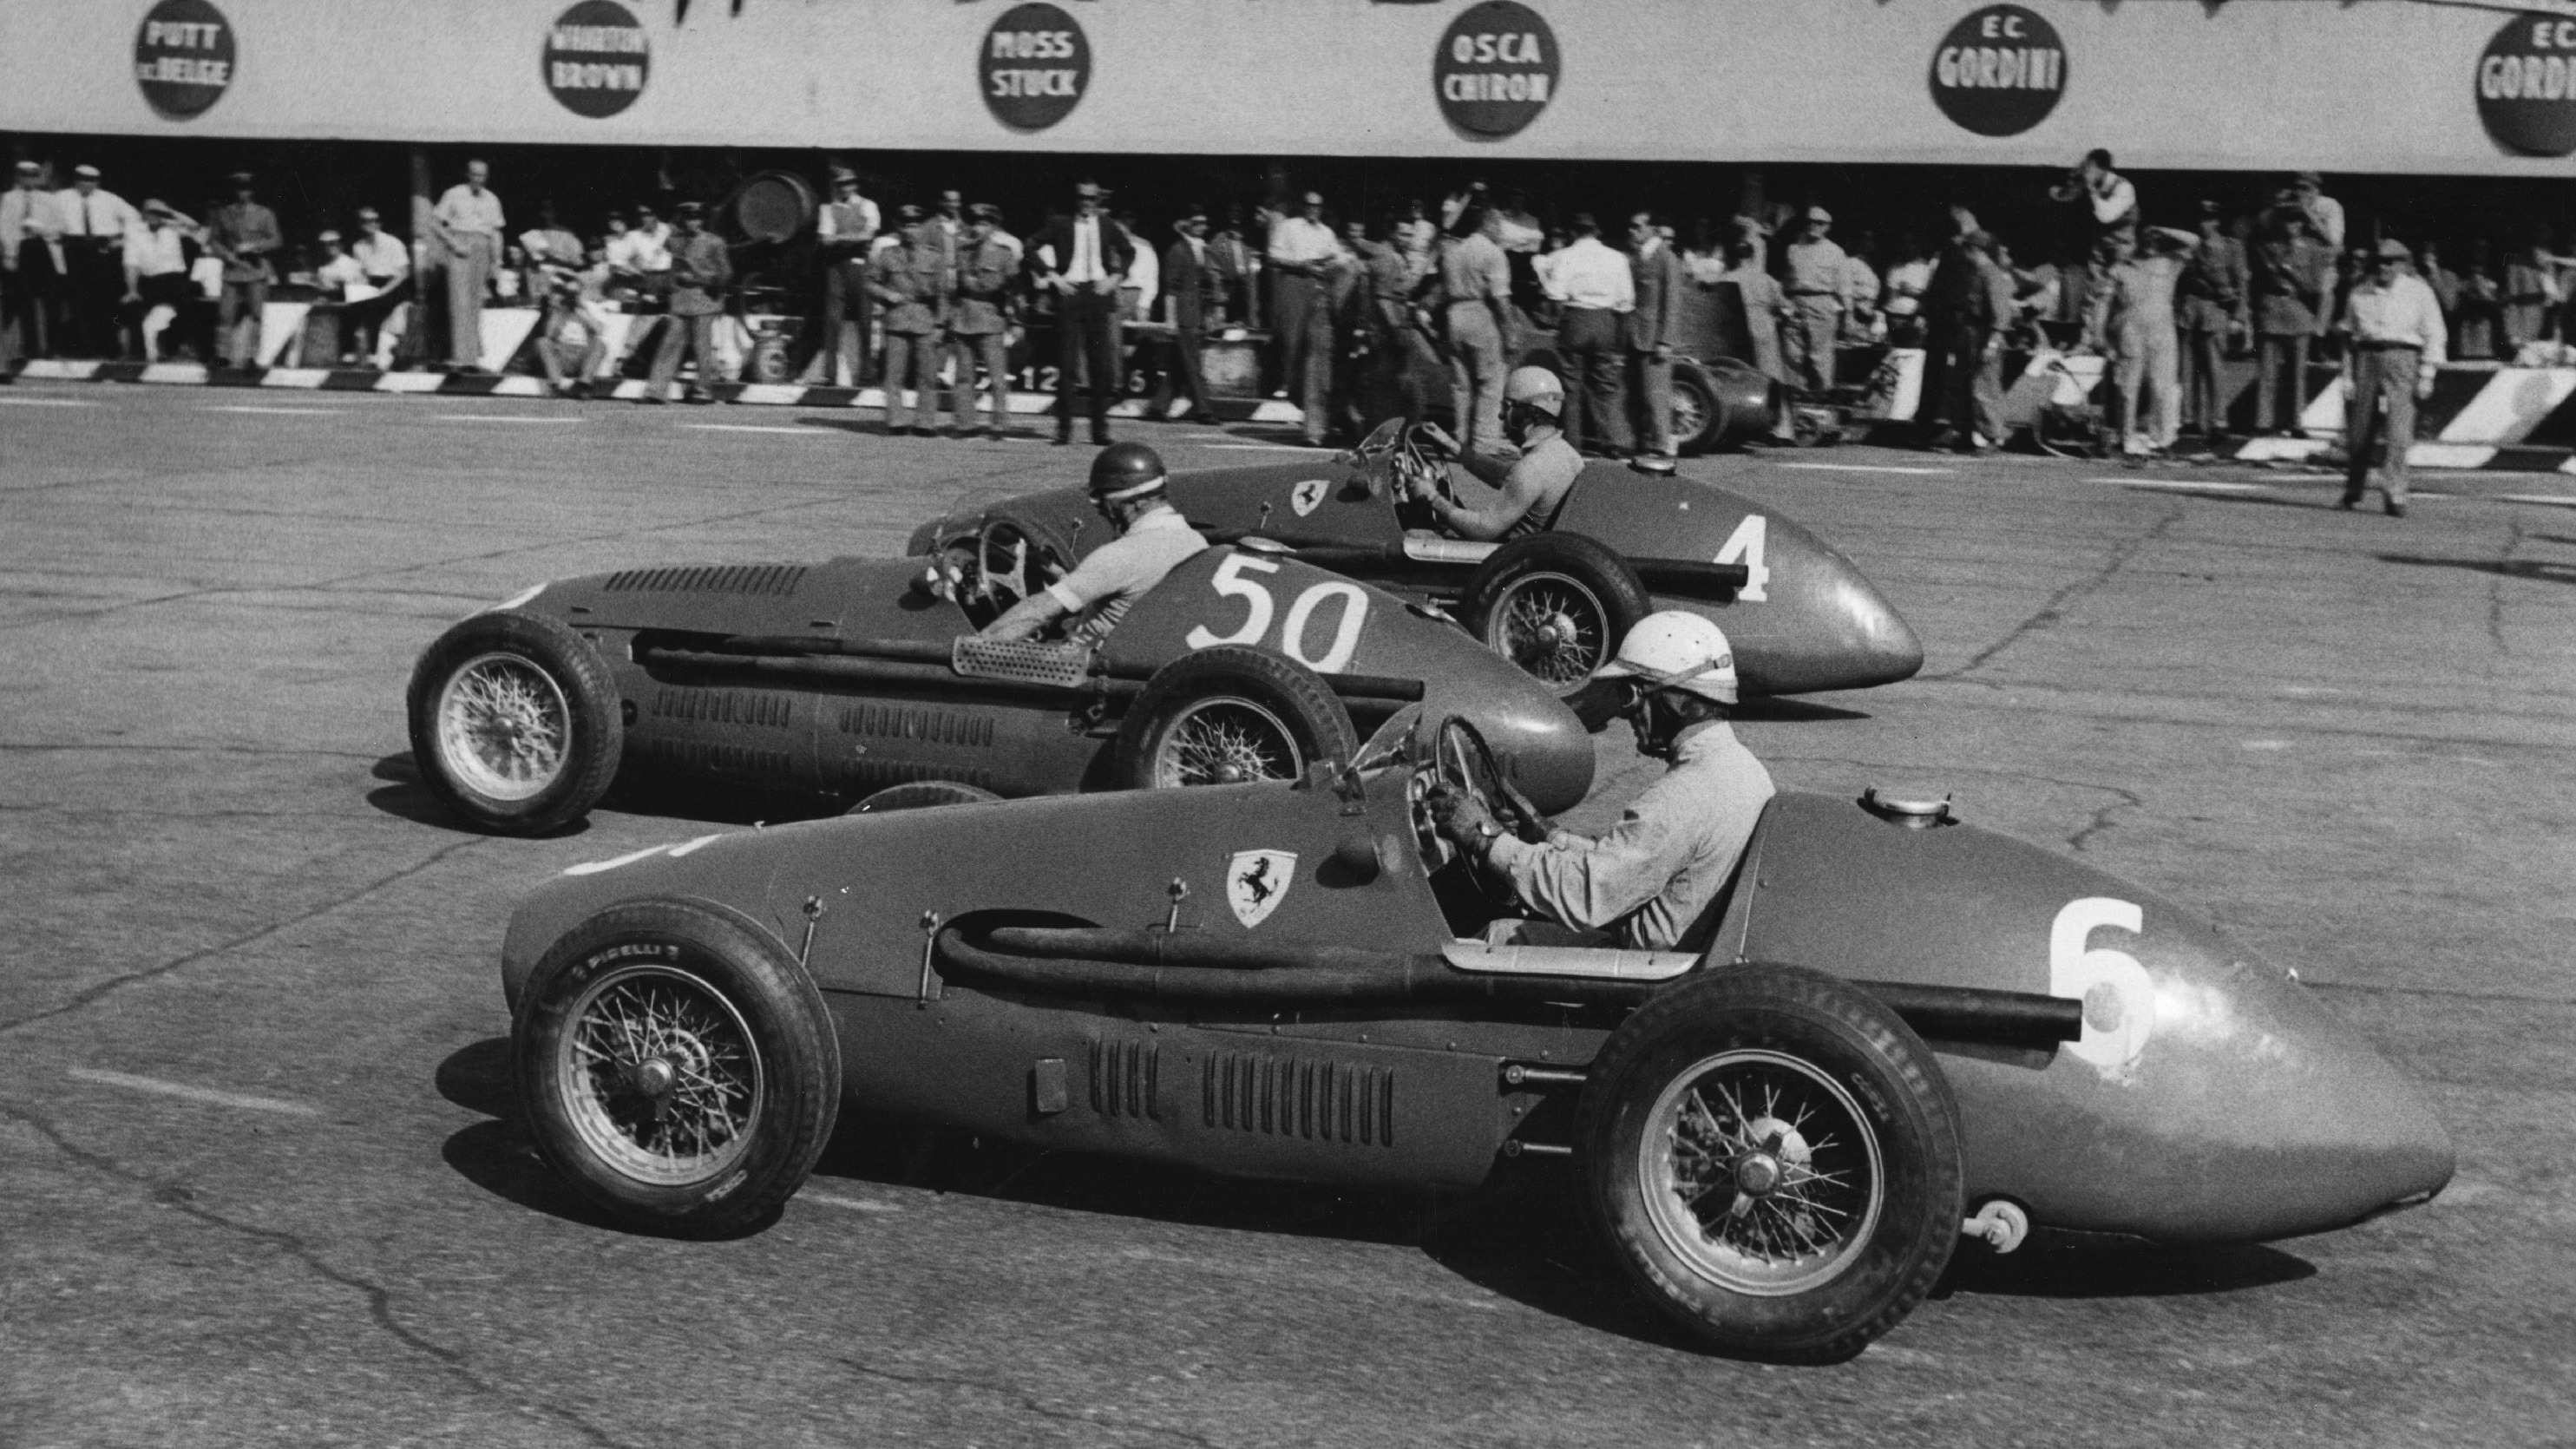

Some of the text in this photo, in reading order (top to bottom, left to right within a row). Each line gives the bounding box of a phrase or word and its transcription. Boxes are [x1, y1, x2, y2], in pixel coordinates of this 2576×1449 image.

[147, 21, 222, 49] PUTT
[1981, 14, 2027, 38] EC
[992, 30, 1075, 58] MOSS
[1452, 32, 1542, 63] OSCA
[552, 60, 642, 90] BROWN
[991, 69, 1078, 97] STUCK
[1937, 46, 2061, 90] GORDINI
[1443, 72, 1549, 102] CHIRON
[1713, 514, 1770, 602] 4
[1185, 553, 1369, 674] 50
[2049, 896, 2155, 1065] 6
